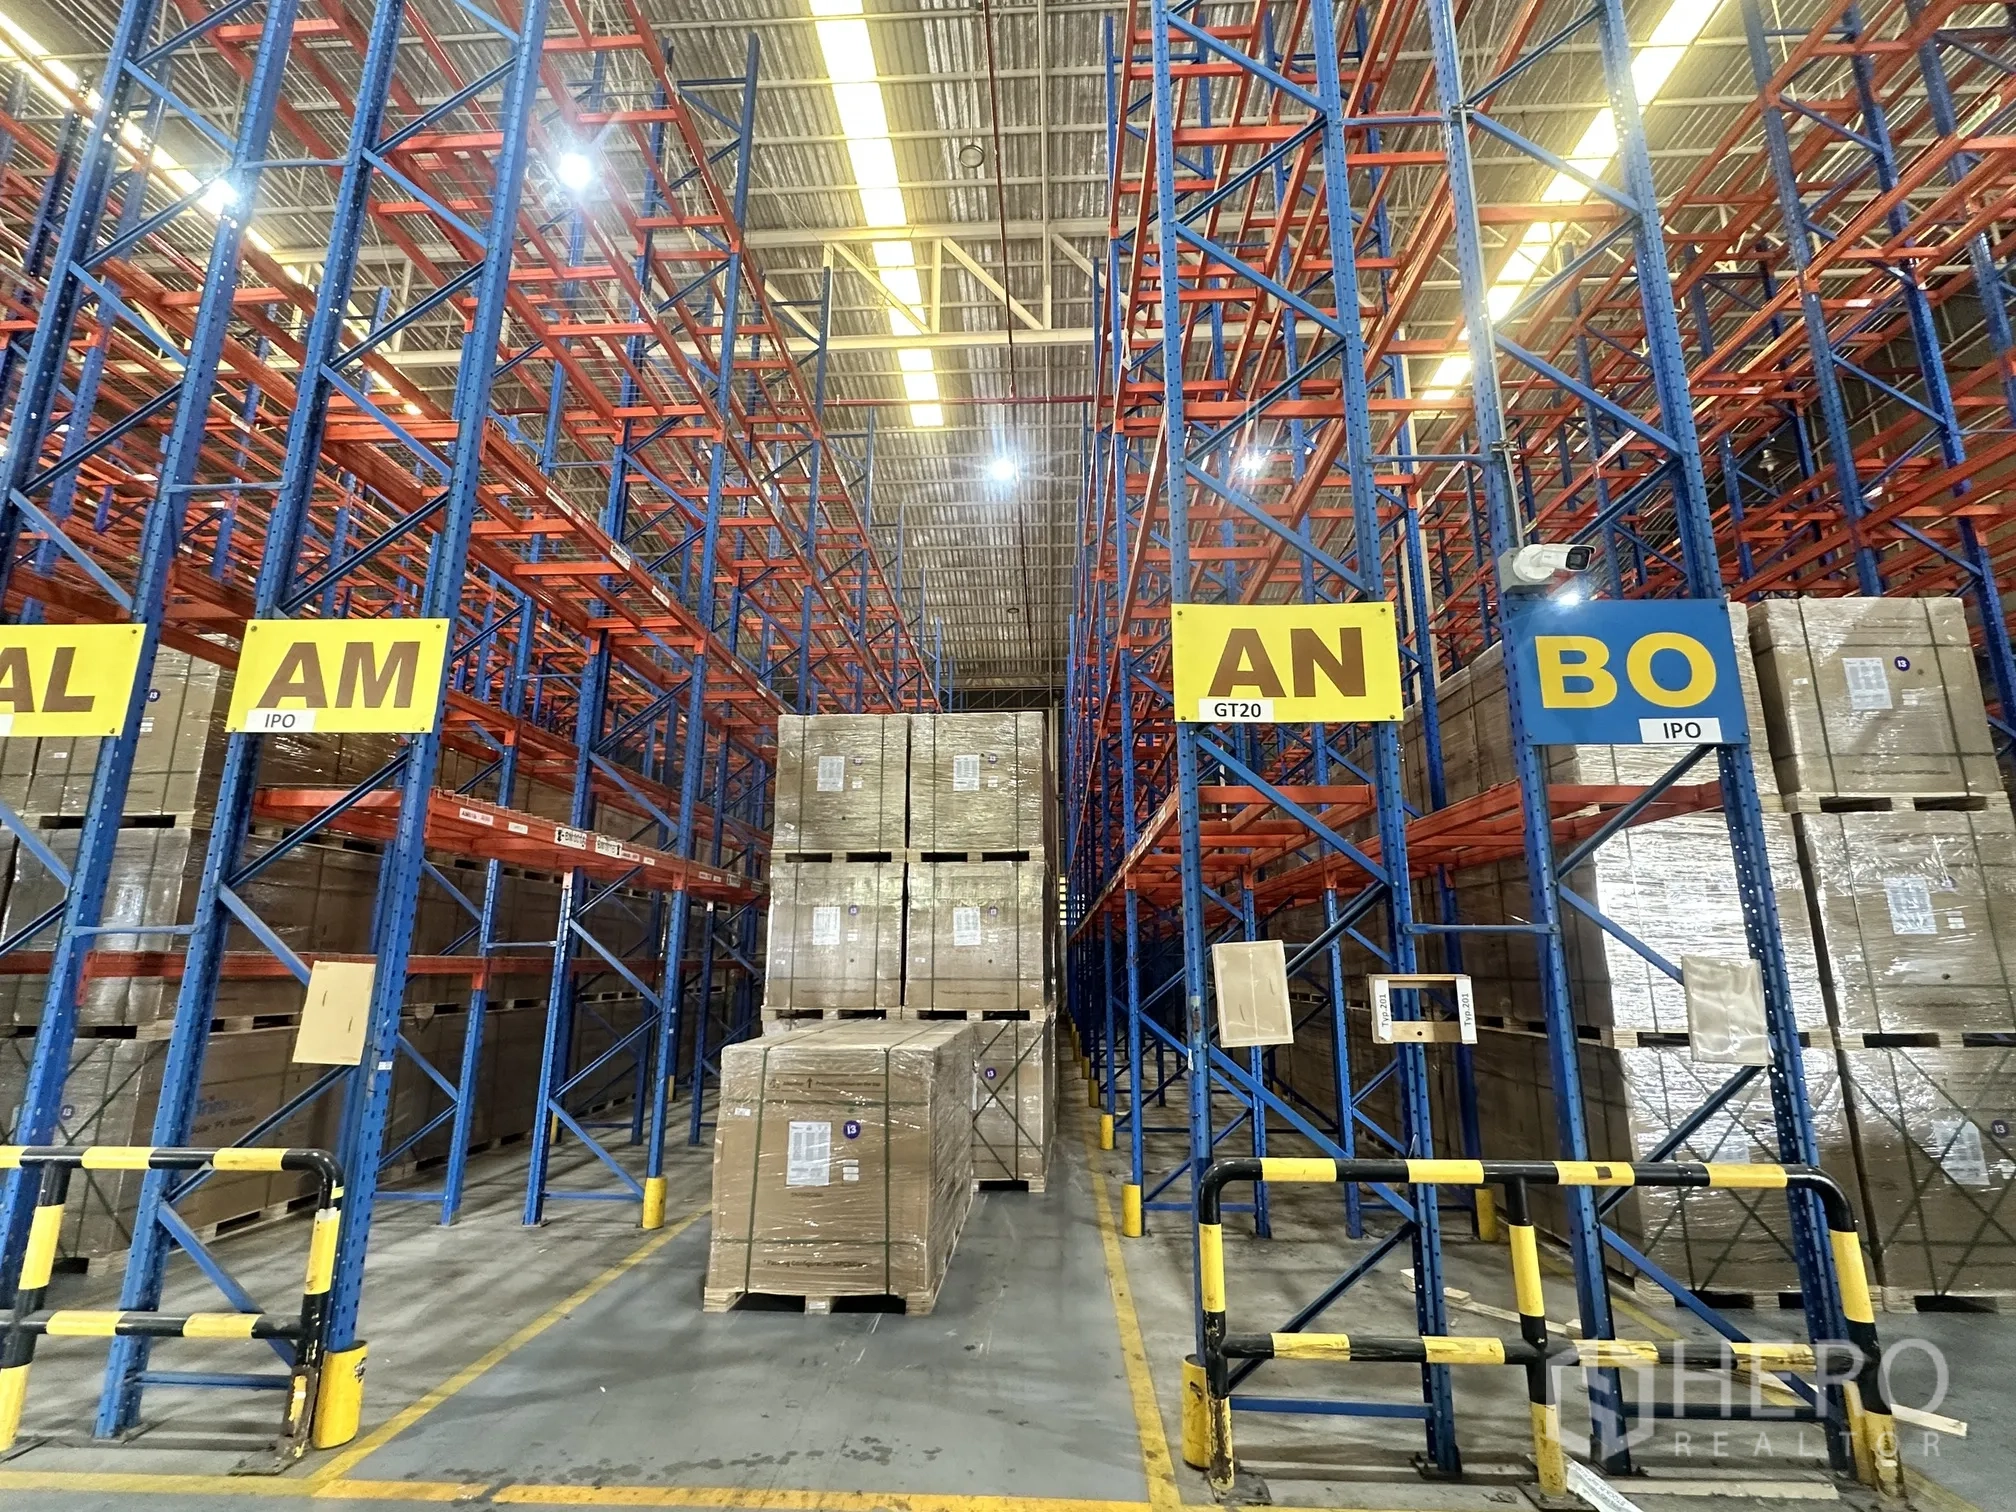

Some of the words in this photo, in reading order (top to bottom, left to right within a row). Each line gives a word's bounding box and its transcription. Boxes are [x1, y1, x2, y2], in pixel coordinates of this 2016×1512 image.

[256, 641, 421, 709] AM
[1207, 627, 1367, 698] AN
[1534, 631, 1718, 709] BO
[265, 713, 296, 729] IPO
[1214, 702, 1262, 719] GT20
[1662, 721, 1702, 739] IPO
[1379, 993, 1391, 1028] Typ.201
[1461, 993, 1473, 1027] Typ.201
